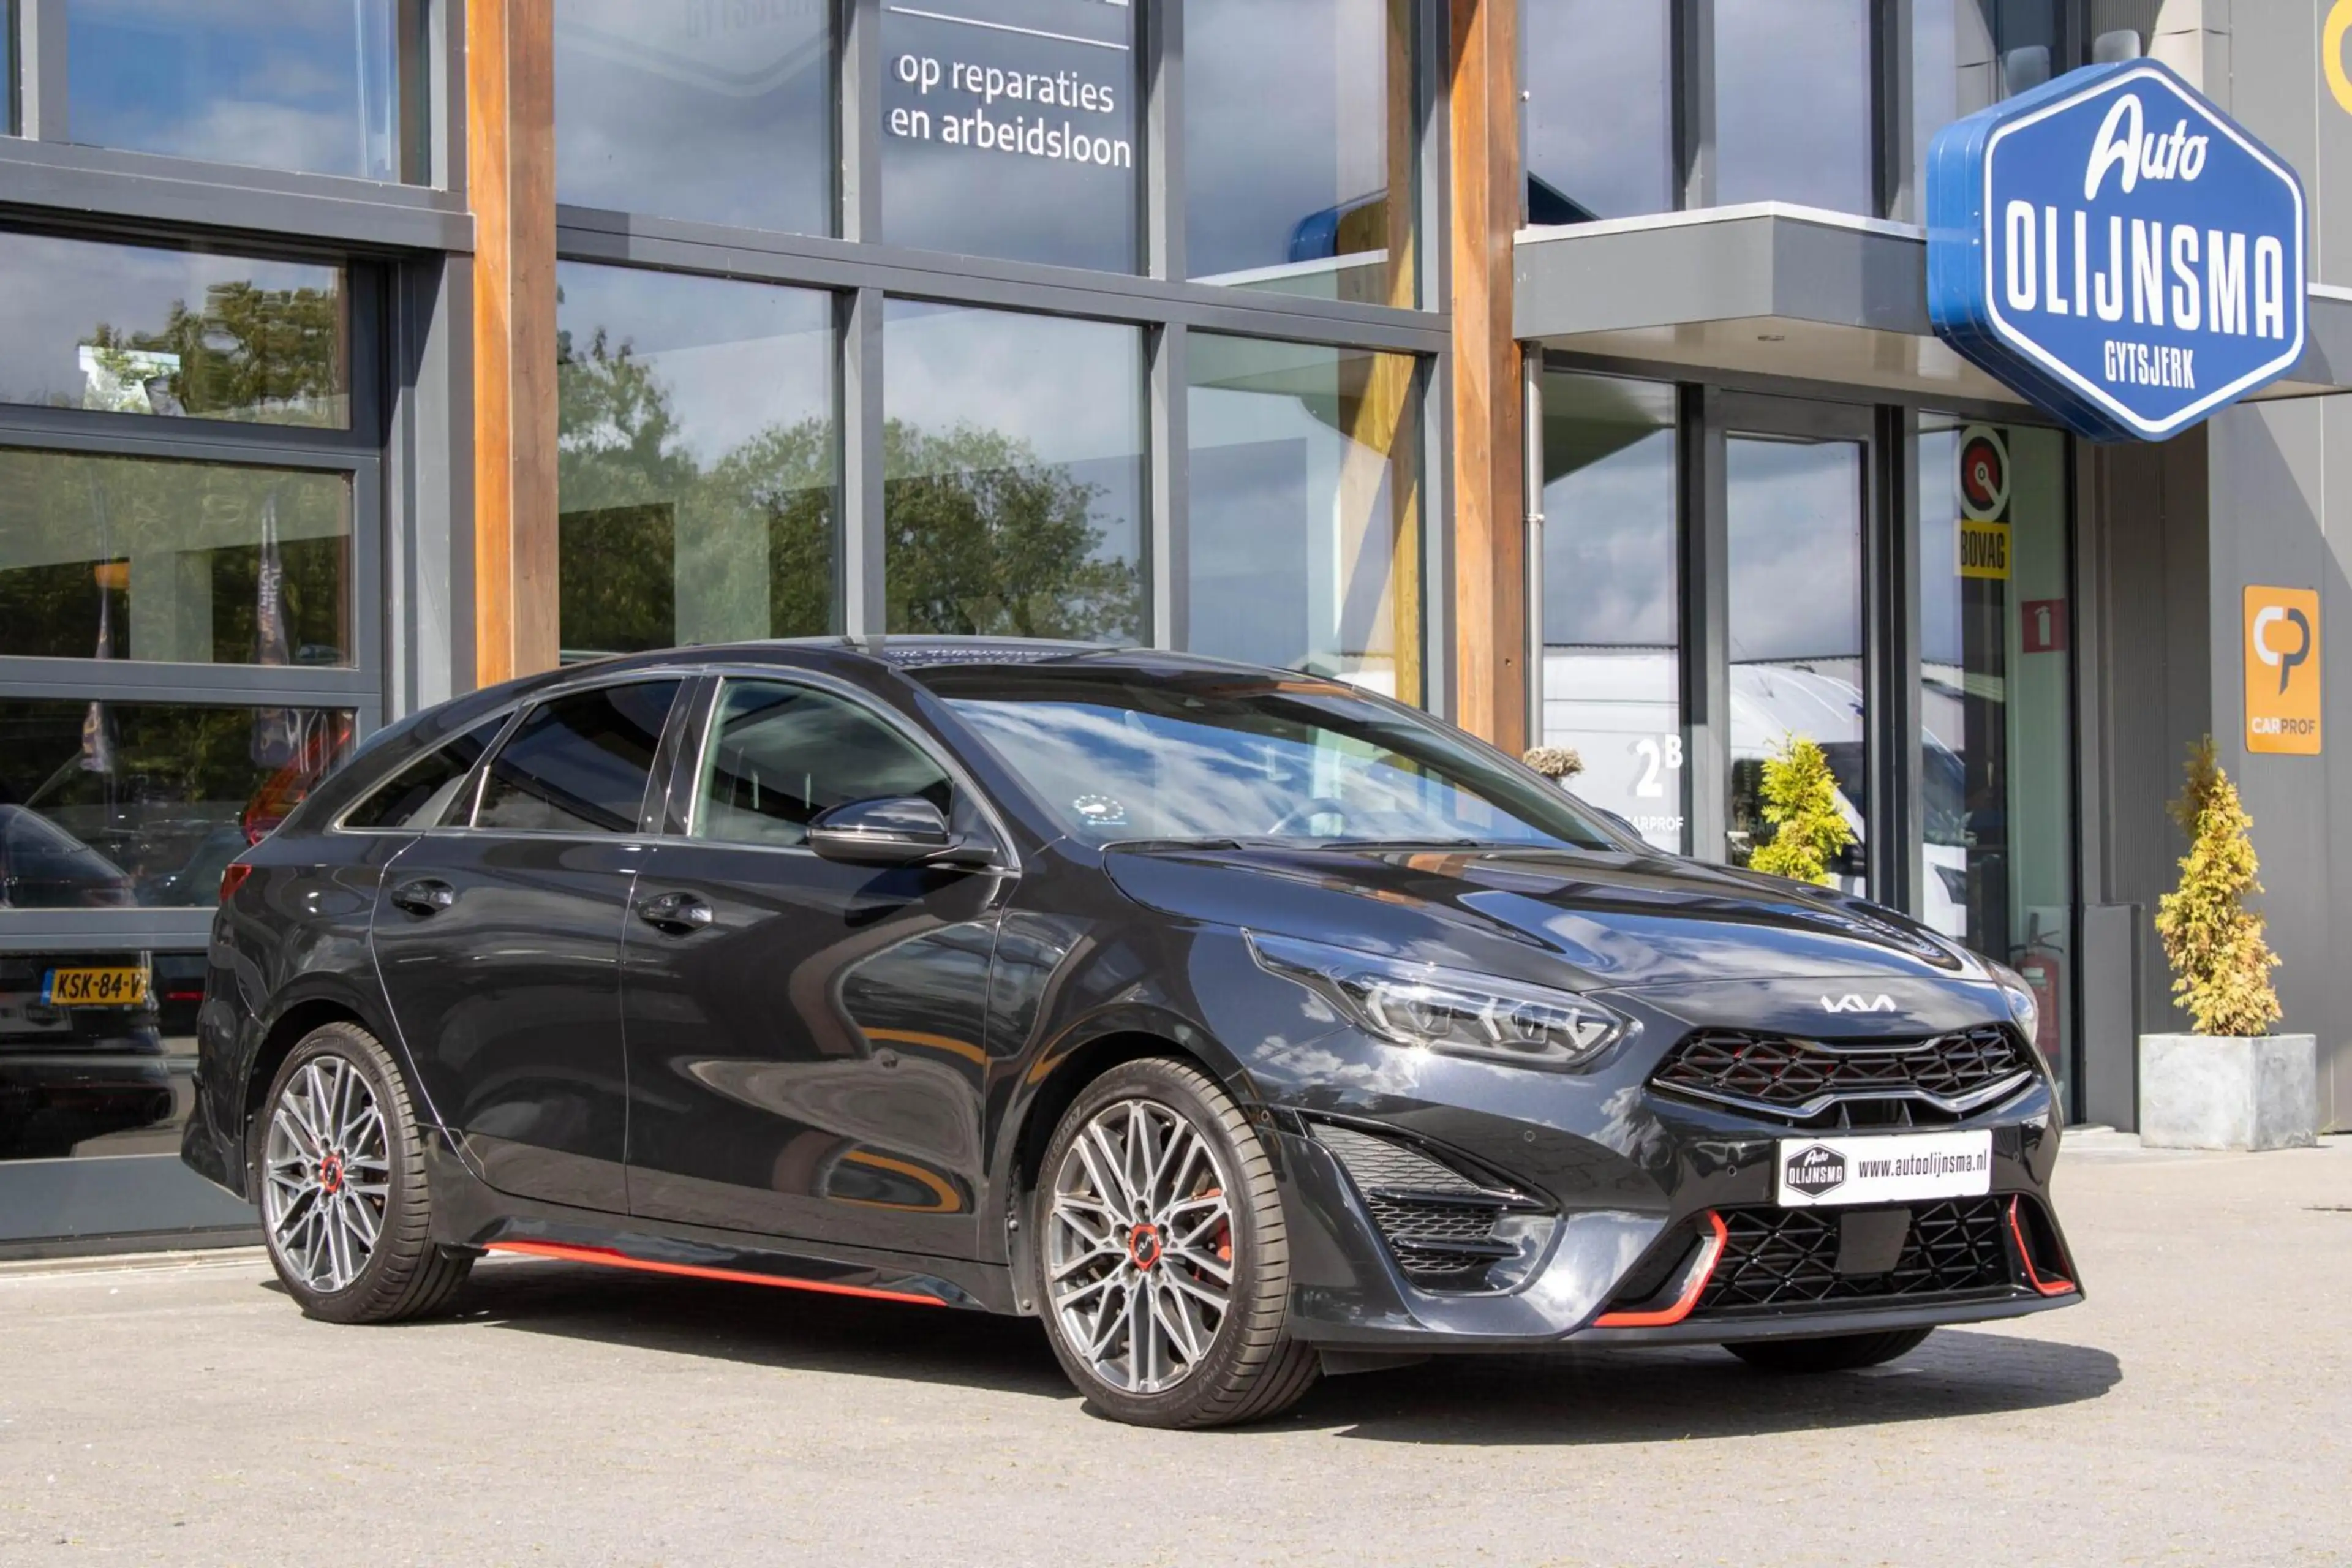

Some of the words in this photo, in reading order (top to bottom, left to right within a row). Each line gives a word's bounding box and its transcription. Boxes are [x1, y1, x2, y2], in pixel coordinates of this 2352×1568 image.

[899, 54, 940, 94] op
[952, 59, 1115, 113] reparaties
[891, 108, 930, 140] en
[942, 108, 1131, 168] arbeidsloon
[2084, 94, 2210, 201] Auto
[2005, 200, 2285, 341] OLIJNSMA
[2104, 340, 2196, 390] GYTSJERK
[1961, 530, 2006, 570] BOVAG
[2252, 717, 2316, 735] CARPROF
[1624, 816, 1684, 831] ARPROF
[1820, 993, 1898, 1013] KIA
[1788, 1166, 1843, 1185] OLIJNSMA
[1804, 1150, 1829, 1167] Auto
[1858, 1149, 1988, 1178] www.autoolijnsma.nl
